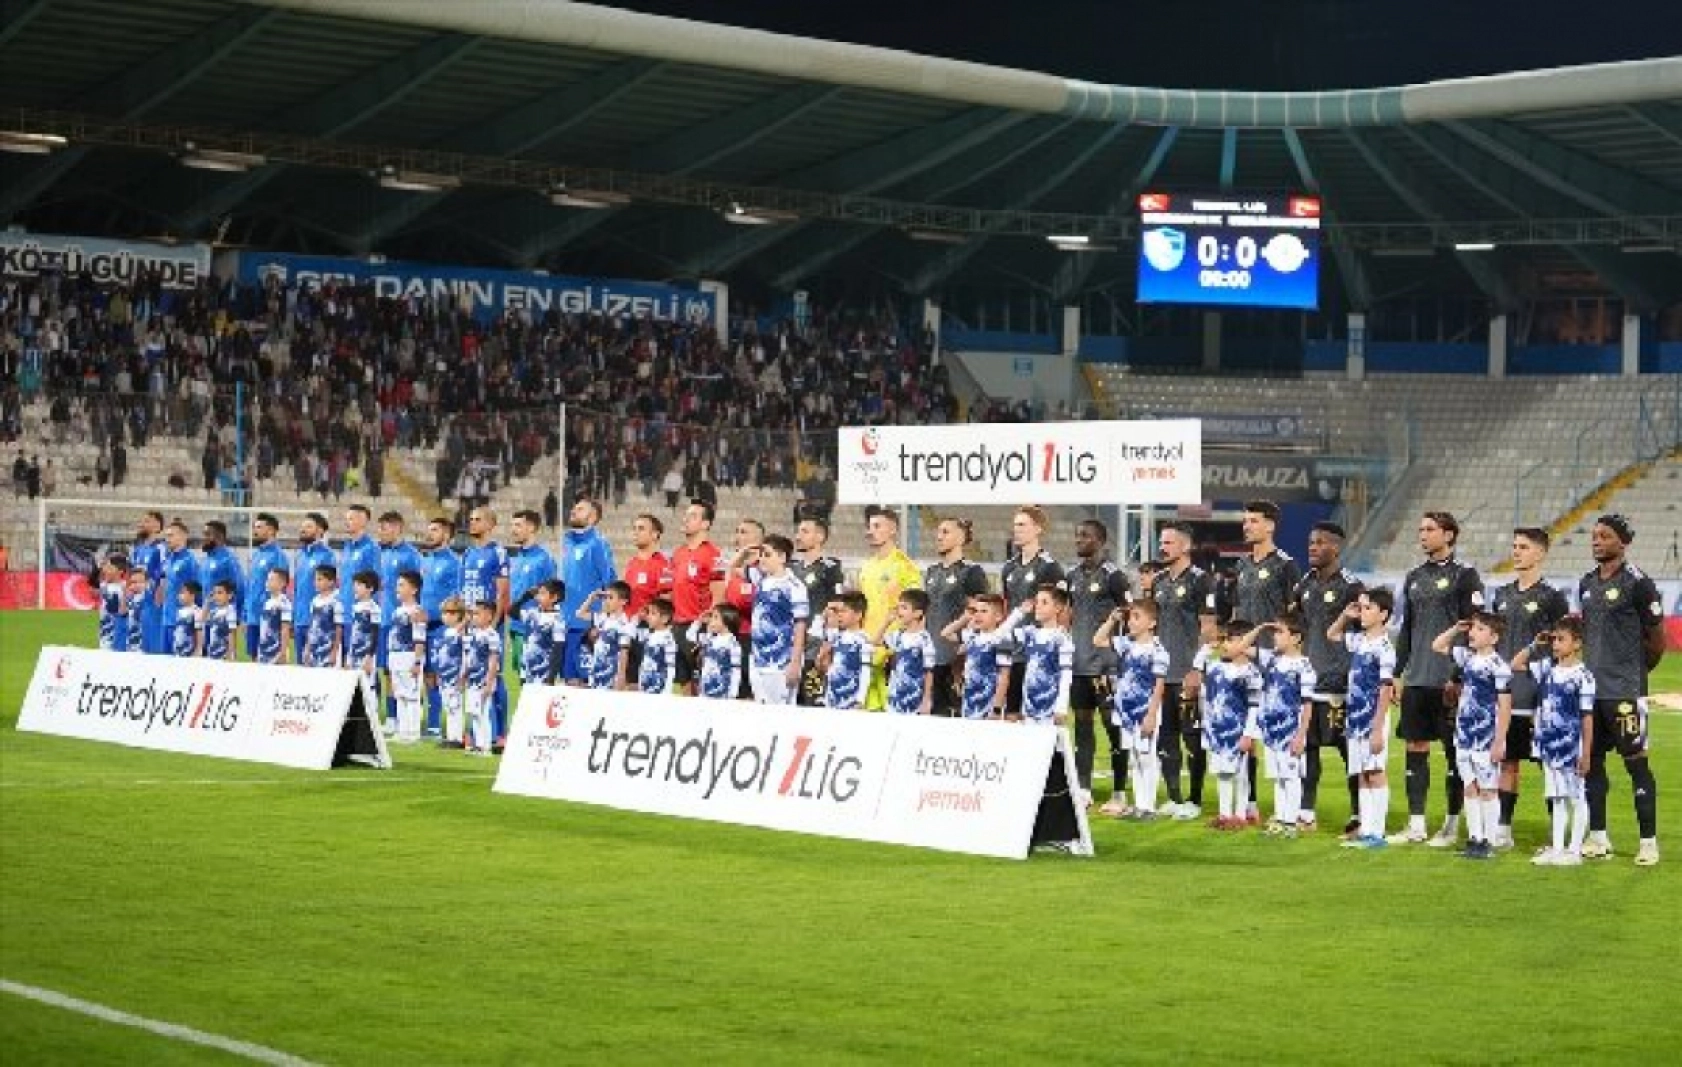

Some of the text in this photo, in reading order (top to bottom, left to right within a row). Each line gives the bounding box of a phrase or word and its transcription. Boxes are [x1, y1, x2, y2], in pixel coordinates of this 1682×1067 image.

[92, 250, 196, 286] GÜNDE
[504, 285, 552, 312] EN
[899, 444, 1032, 489] trendyol
[1121, 441, 1183, 462] trendyol
[76, 674, 195, 733] trendyol
[1616, 715, 1639, 736] 78
[588, 716, 778, 800] trendyol
[915, 748, 1008, 785] trendyol
[916, 788, 984, 812] yemek
